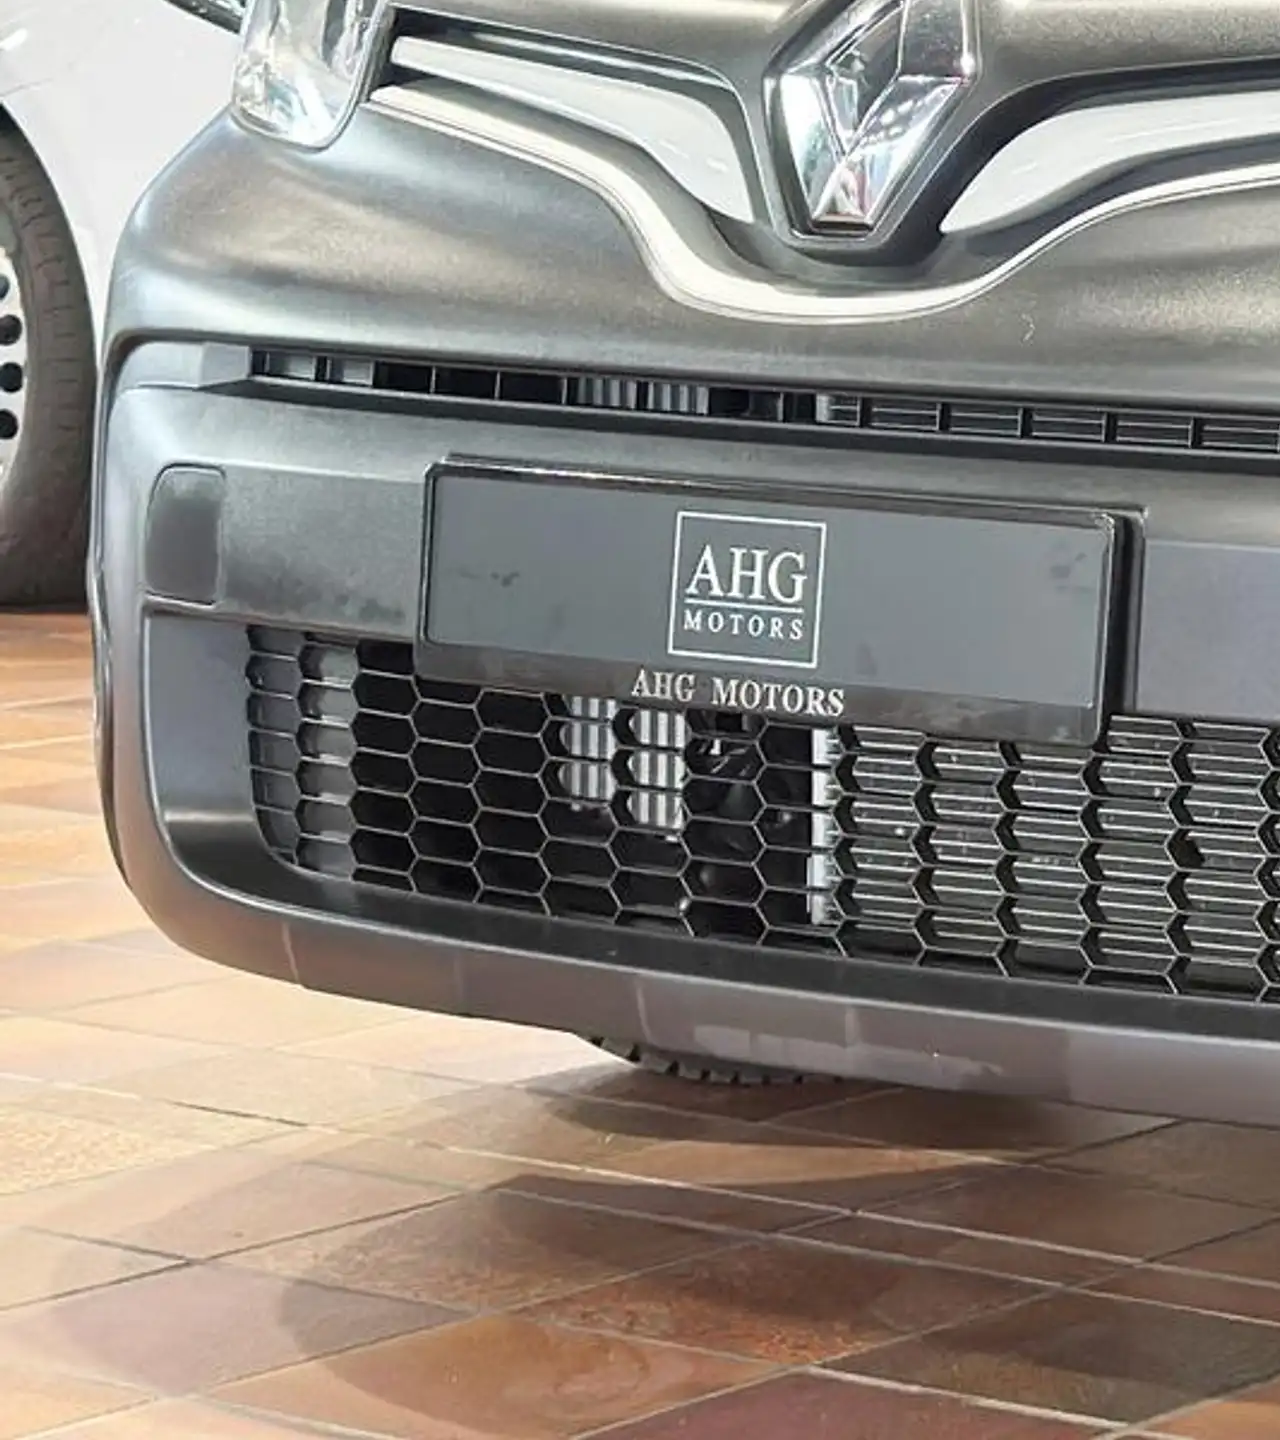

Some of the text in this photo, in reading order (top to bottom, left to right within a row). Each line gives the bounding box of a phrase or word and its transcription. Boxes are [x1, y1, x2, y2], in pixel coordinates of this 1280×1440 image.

[684, 543, 808, 605] AHG
[683, 609, 804, 641] MOTORS
[631, 669, 845, 717] AHG MOTORS
